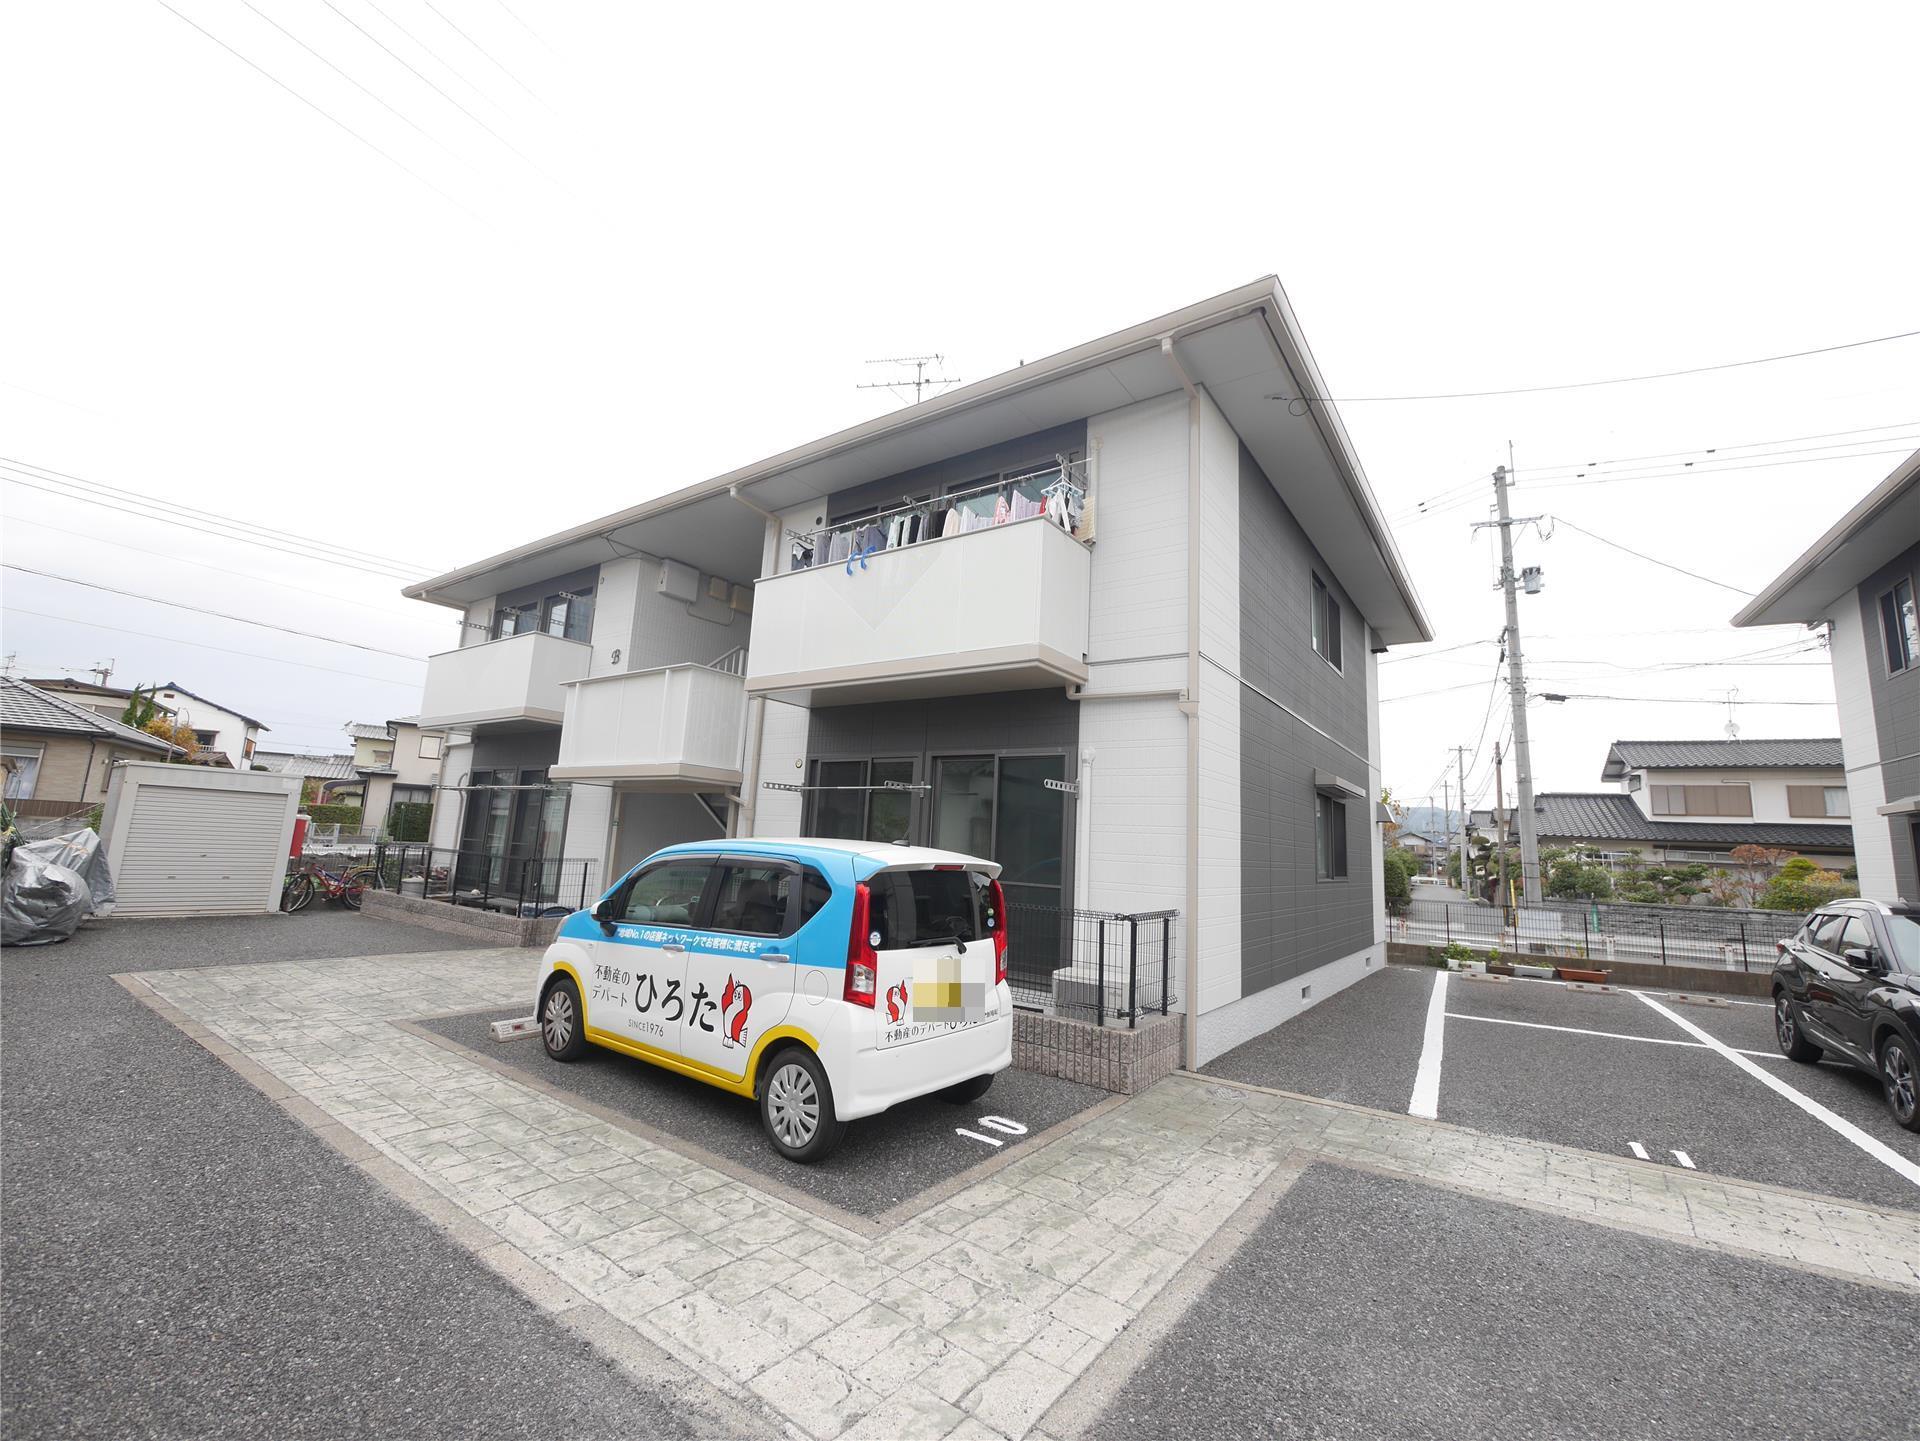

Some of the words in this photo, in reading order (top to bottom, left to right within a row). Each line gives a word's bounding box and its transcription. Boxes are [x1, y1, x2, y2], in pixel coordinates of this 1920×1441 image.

[611, 649, 621, 665] B
[594, 964, 630, 986] 不動産の
[592, 984, 628, 1007] デパート
[635, 973, 717, 1033] ひろた
[955, 1115, 1028, 1147] 10
